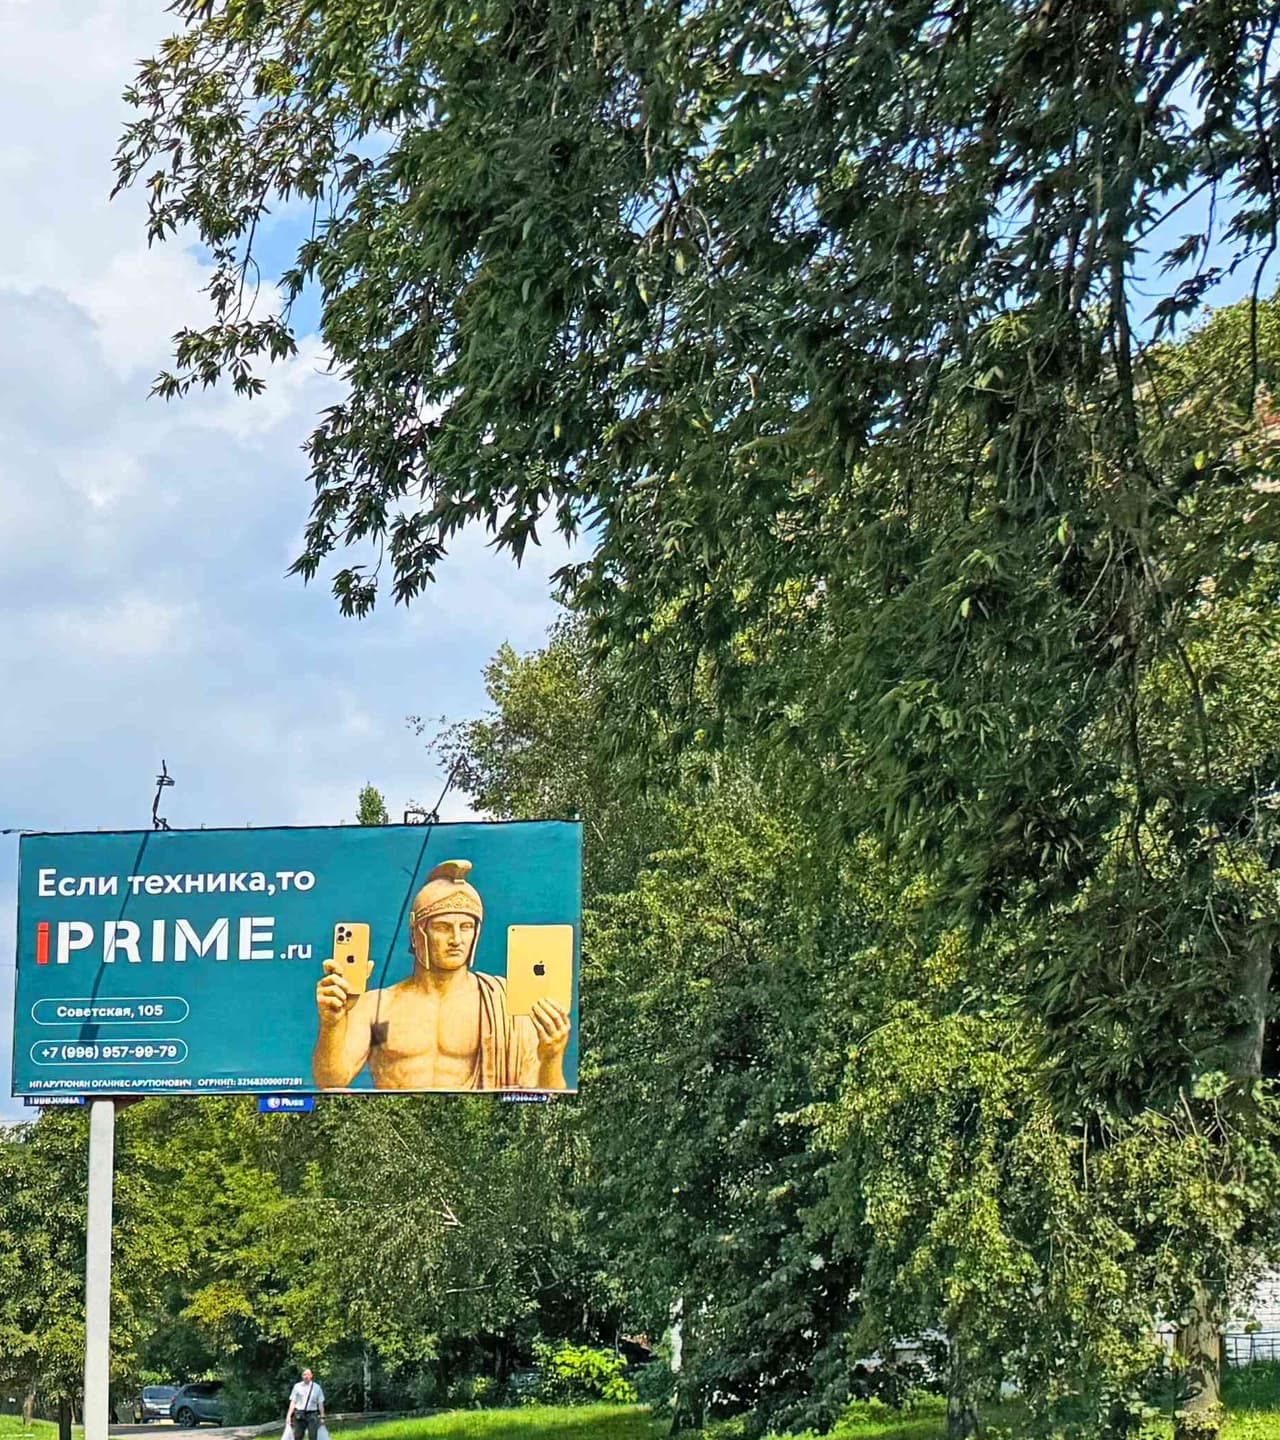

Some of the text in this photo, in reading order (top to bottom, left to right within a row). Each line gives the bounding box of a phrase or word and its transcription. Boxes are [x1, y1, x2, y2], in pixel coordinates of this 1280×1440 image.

[38, 868, 118, 897] Если
[56, 1004, 164, 1019] Советская, 105
[42, 1045, 178, 1060] +7 (996) 957-99-79
